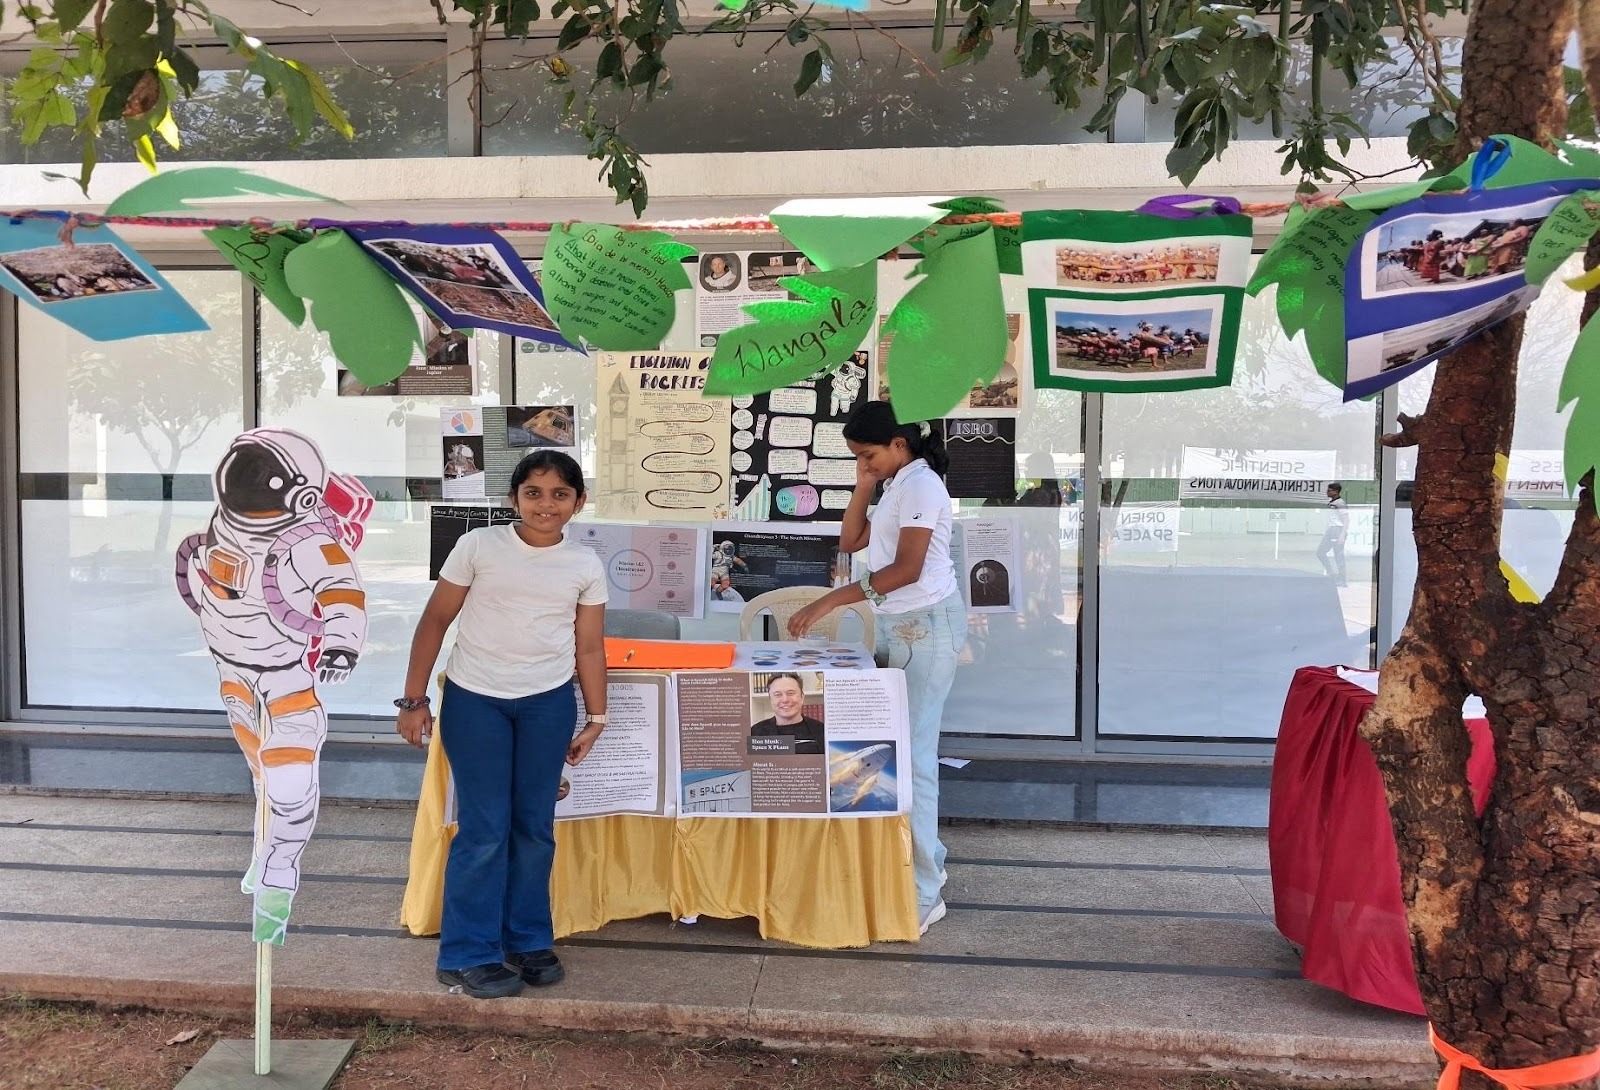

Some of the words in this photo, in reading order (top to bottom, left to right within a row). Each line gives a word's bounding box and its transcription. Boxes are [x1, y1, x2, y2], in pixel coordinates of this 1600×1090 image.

[564, 239, 587, 262] What
[554, 246, 587, 283] honoring
[640, 372, 706, 390] ROCKETS
[956, 422, 993, 435] ISRO
[700, 776, 741, 797] SPACEX
